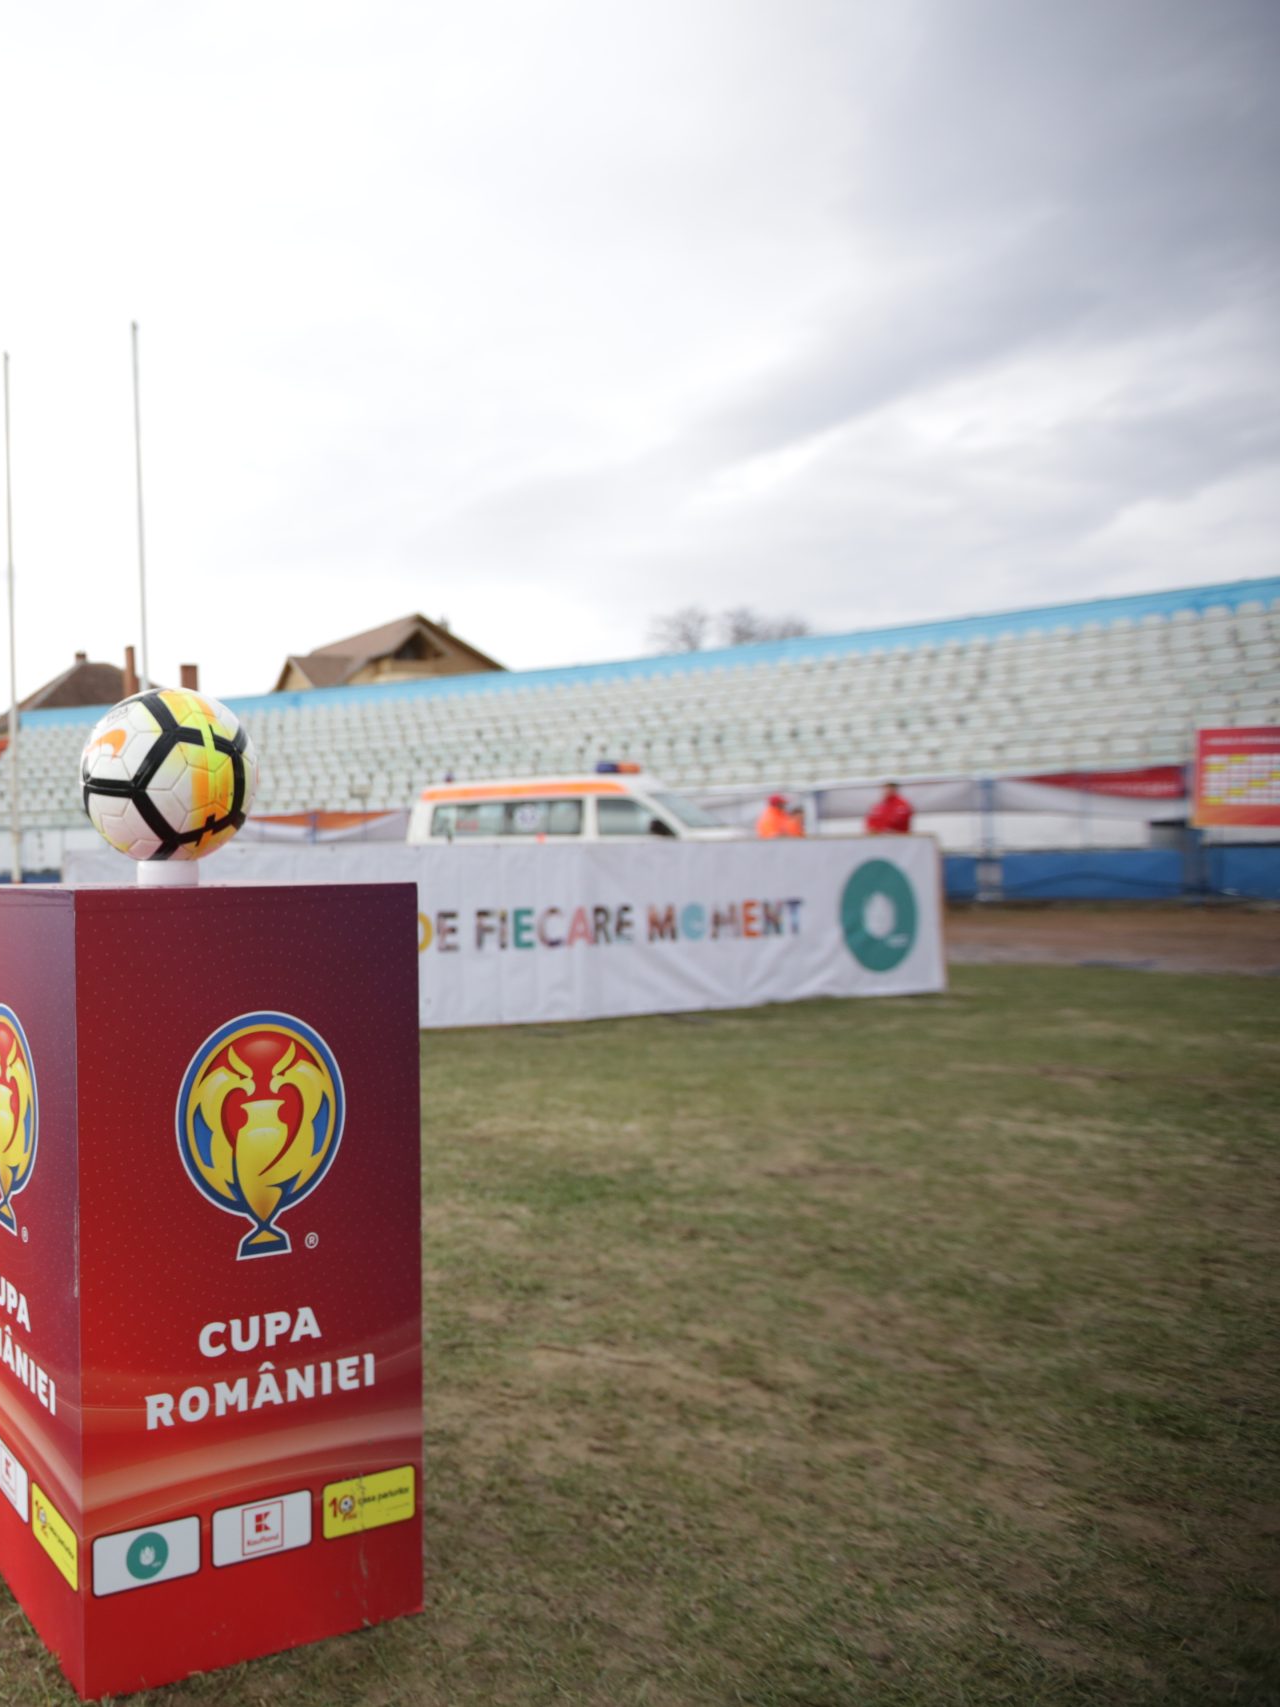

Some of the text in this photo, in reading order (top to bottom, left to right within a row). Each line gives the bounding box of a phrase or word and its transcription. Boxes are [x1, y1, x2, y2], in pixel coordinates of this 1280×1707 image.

[475, 904, 634, 951] FIECARE
[647, 898, 804, 943] MOMENT
[198, 1306, 322, 1358] CUPA
[144, 1353, 376, 1431] ROMÂNIEI
